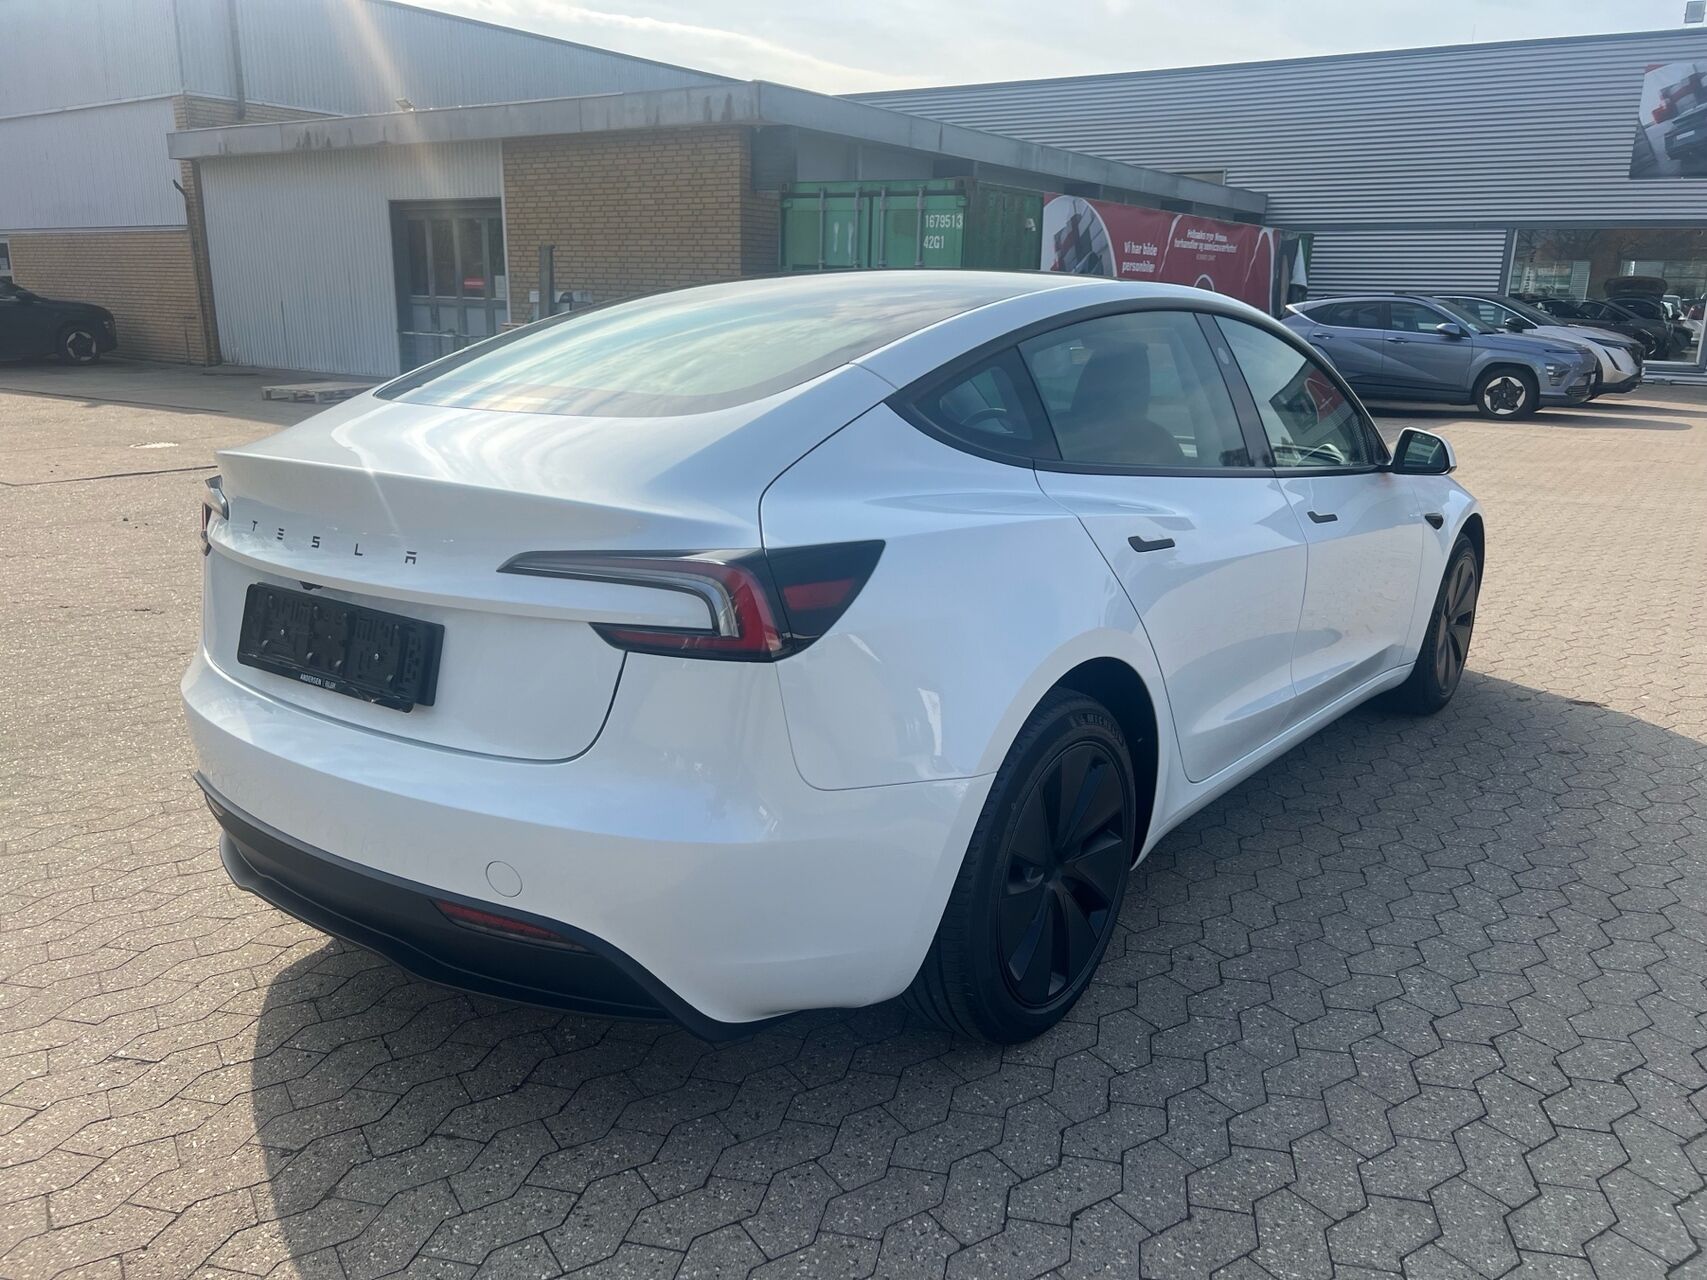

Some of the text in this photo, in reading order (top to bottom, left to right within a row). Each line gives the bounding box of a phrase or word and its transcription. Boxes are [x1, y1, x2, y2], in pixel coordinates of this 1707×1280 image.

[925, 214, 963, 228] 1679513
[923, 235, 945, 249] 42G1
[1124, 241, 1131, 253] Vi
[1131, 242, 1141, 254] har
[252, 520, 417, 565] TESLA
